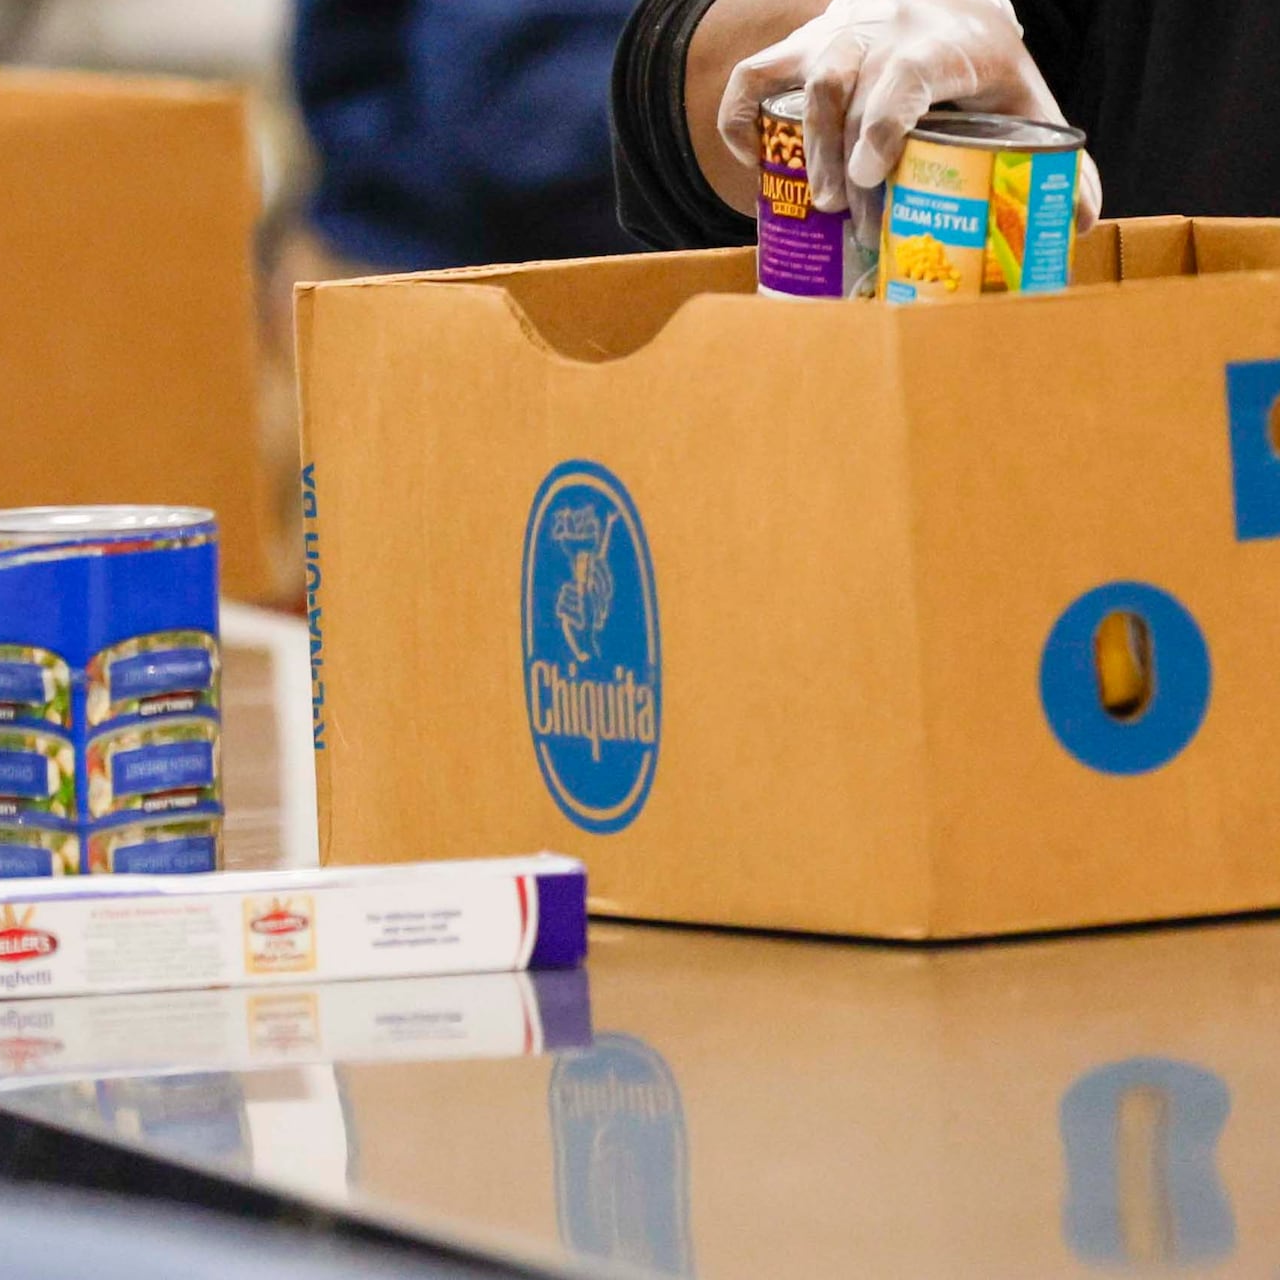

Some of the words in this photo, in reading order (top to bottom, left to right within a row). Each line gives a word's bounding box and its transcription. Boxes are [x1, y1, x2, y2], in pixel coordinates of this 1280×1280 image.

[762, 171, 814, 206] DAKOTA
[893, 203, 931, 227] CREAM
[934, 212, 979, 233] STYLE
[530, 661, 655, 762] Chiquita
